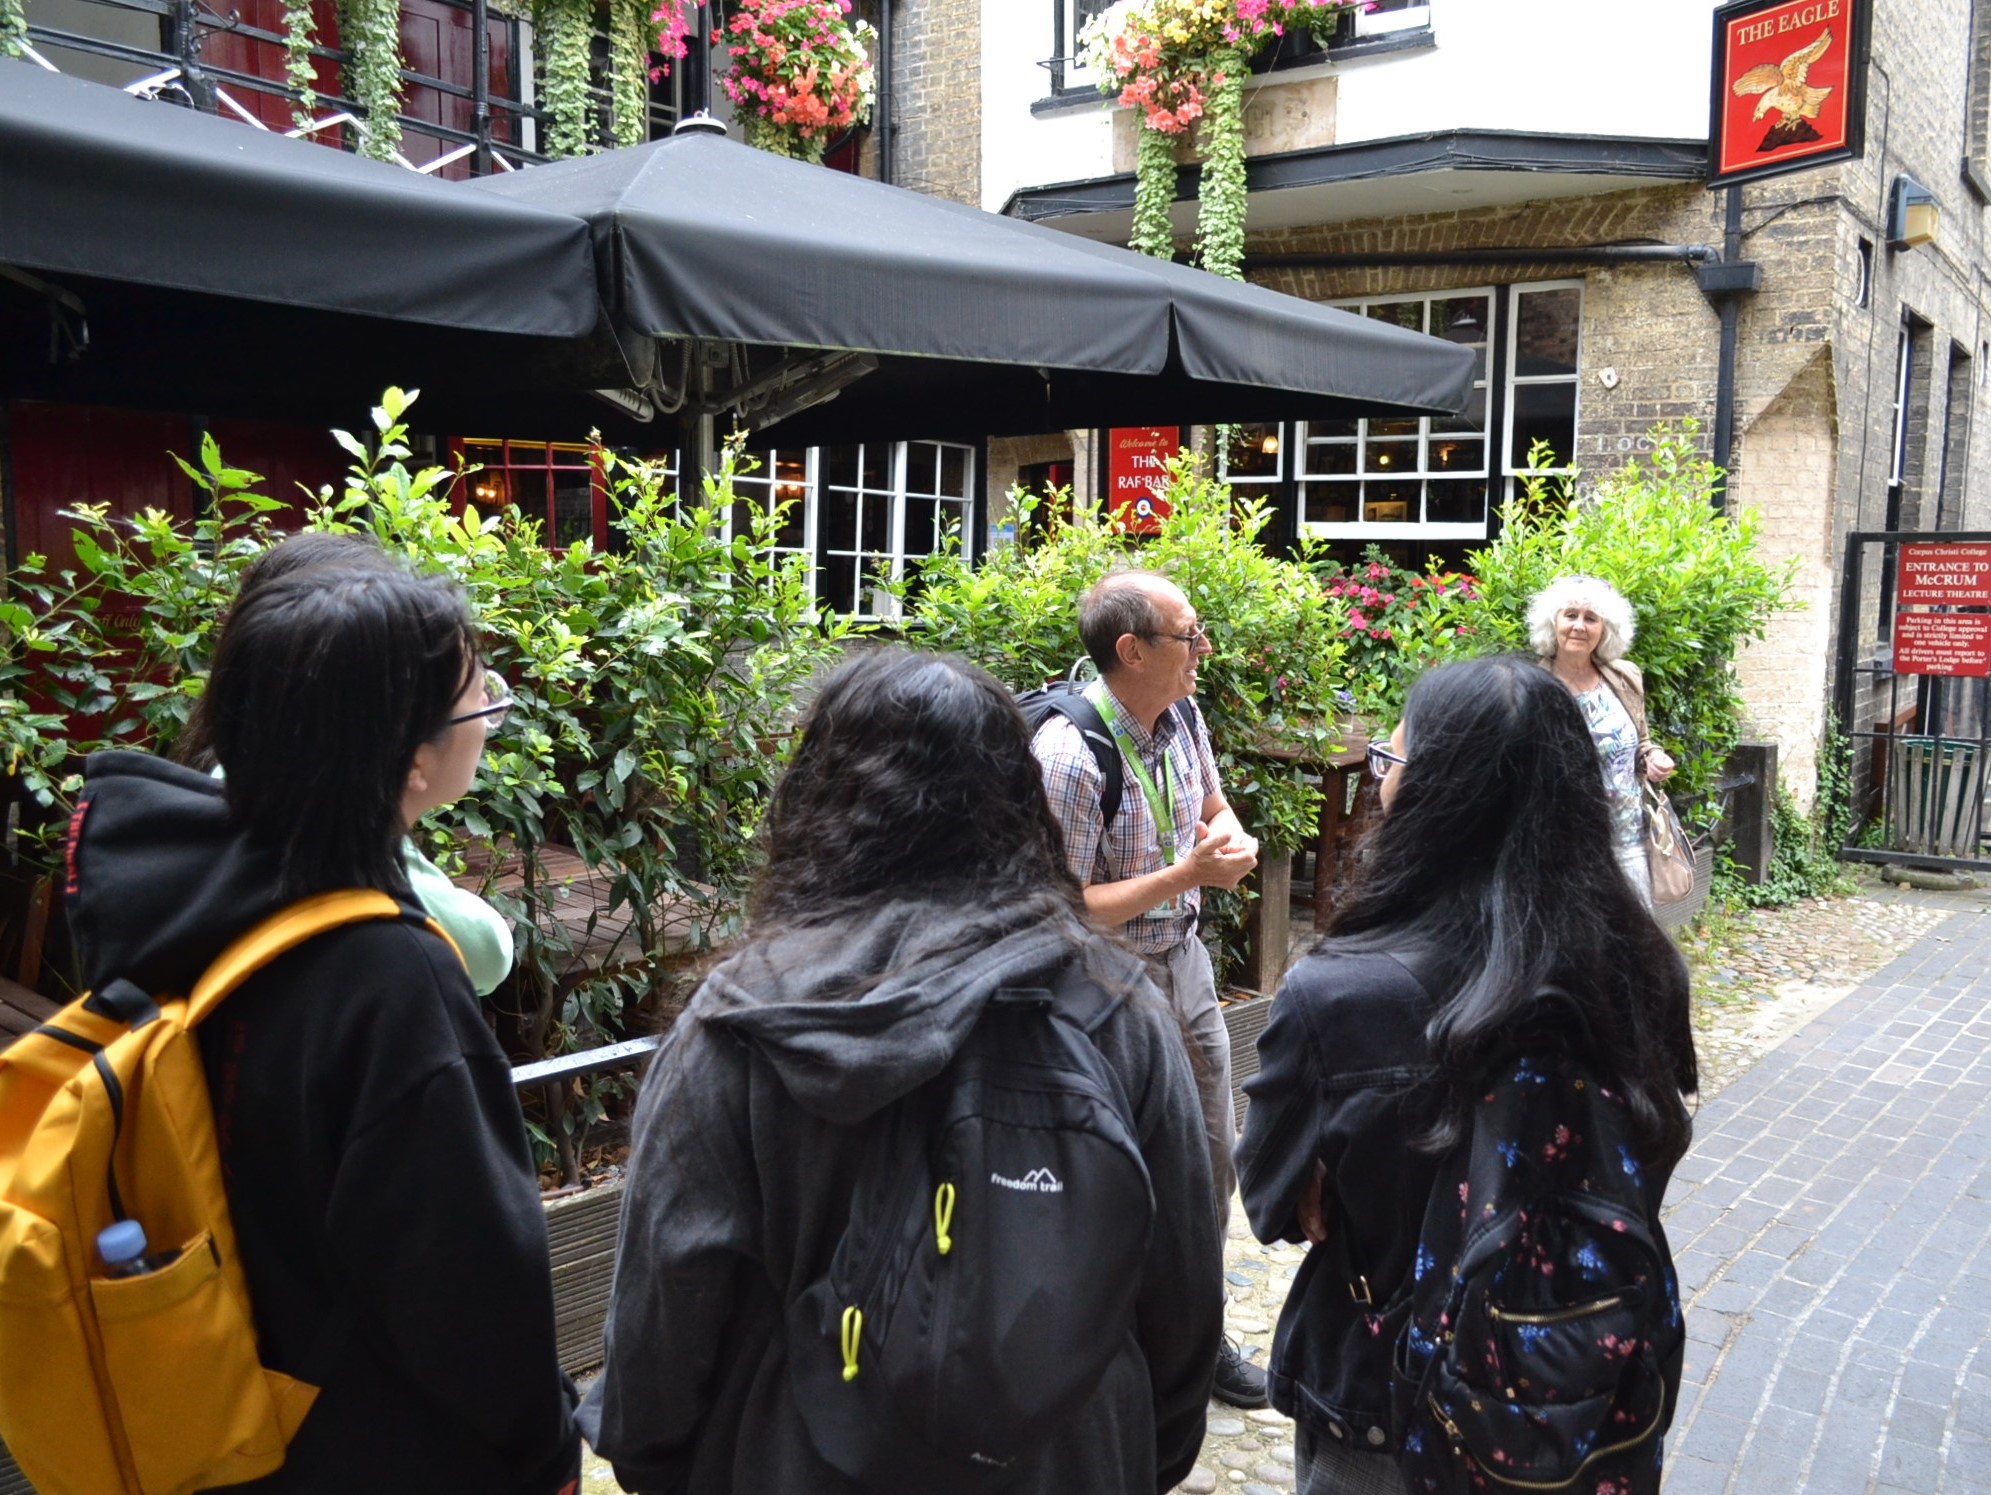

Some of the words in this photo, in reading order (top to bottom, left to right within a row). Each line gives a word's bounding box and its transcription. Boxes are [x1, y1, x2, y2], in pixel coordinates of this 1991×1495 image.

[1737, 19, 1774, 46] THE
[1778, 0, 1840, 33] EAGLE
[1119, 438, 1157, 448] Welcome
[1159, 437, 1169, 447] to
[1131, 455, 1156, 469] THE
[1118, 475, 1141, 489] RAF
[1144, 474, 1170, 489] BAR
[1908, 548, 1933, 557] Corpus
[1934, 548, 1959, 556] Christi
[1960, 548, 1987, 557] College
[1905, 562, 1970, 572] ENTRANCE
[1973, 562, 1989, 572] TO
[1915, 574, 1977, 586] McCRUM
[1903, 589, 1944, 598] LECTURE
[1946, 590, 1988, 599] THEATRE
[1906, 616, 1932, 625] Parking
[1974, 617, 1981, 625] is
[1898, 624, 1921, 632] subject
[1931, 624, 1957, 632] College
[1924, 632, 1947, 640] strictly
[1949, 632, 1974, 640] limited
[1938, 656, 1960, 664] Lodge
[990, 1172, 1037, 1192] freedom
[1040, 1181, 1063, 1192] trail
